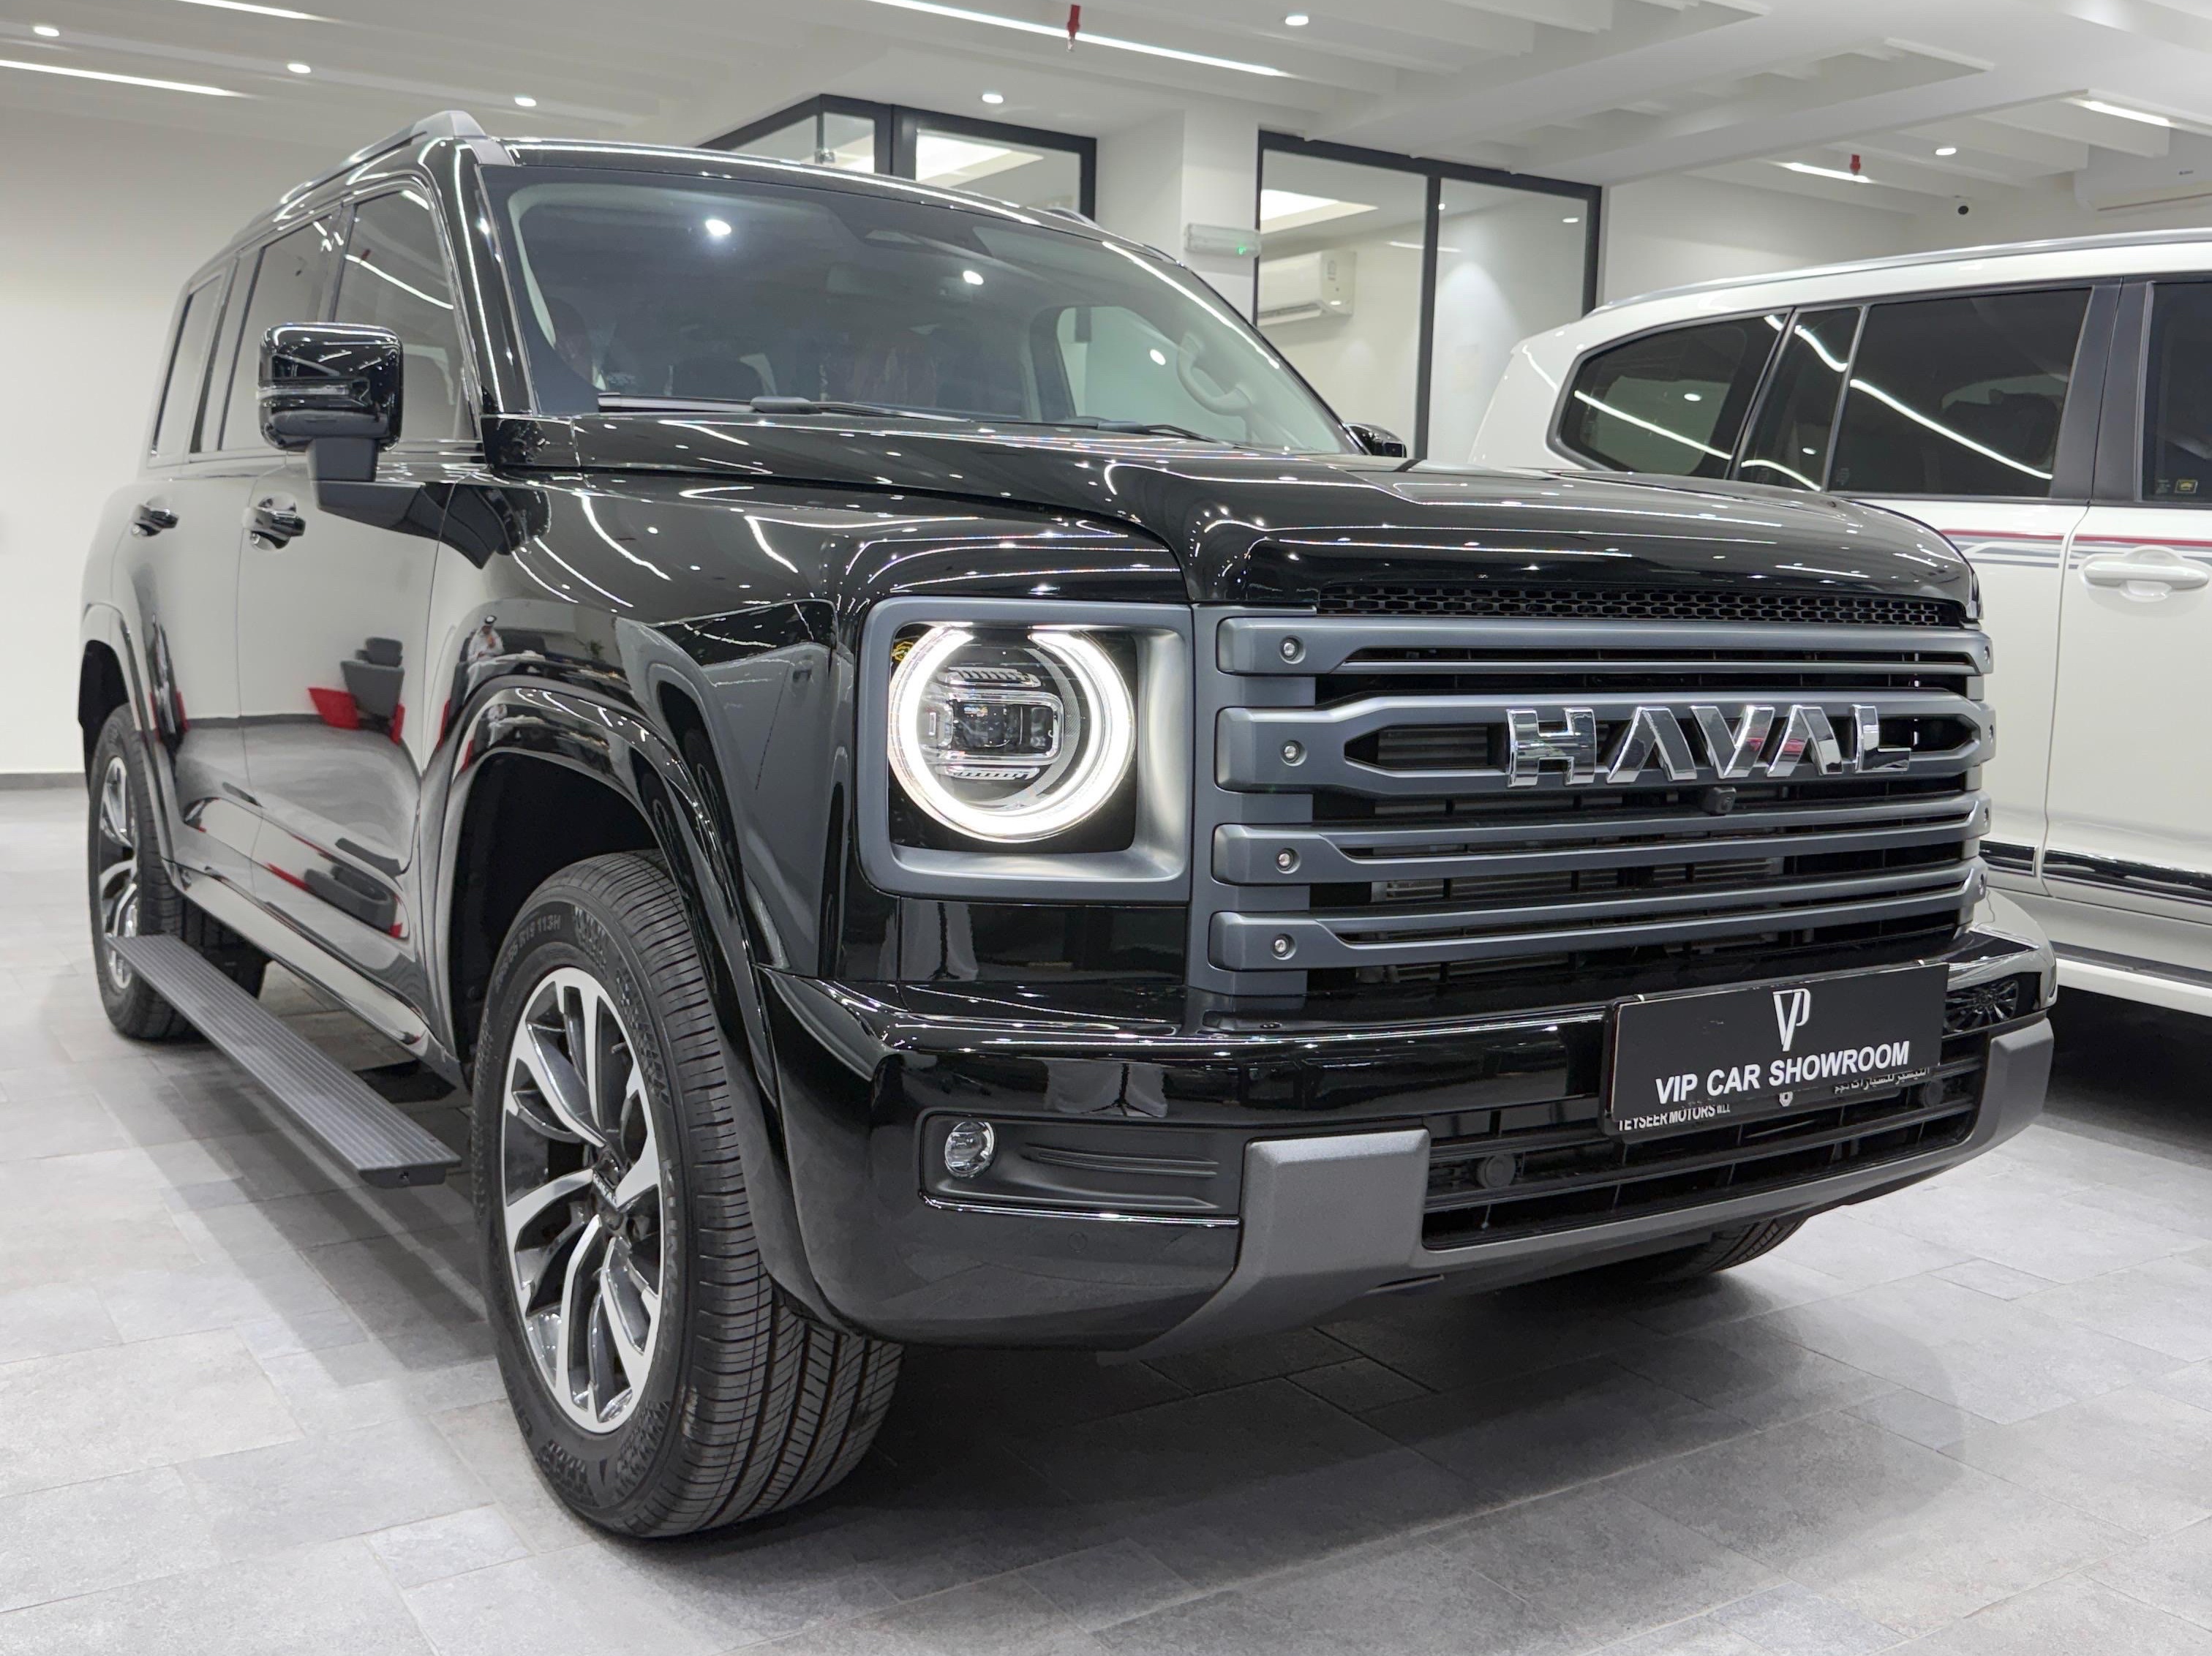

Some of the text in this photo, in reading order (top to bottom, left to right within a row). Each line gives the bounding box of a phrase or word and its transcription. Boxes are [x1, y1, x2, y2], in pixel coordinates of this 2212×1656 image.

[1506, 704, 1911, 789] HAVAL
[1655, 1040, 1910, 1104] VIP CAR SHOWROOM
[1669, 1104, 1716, 1124] MOTORS
